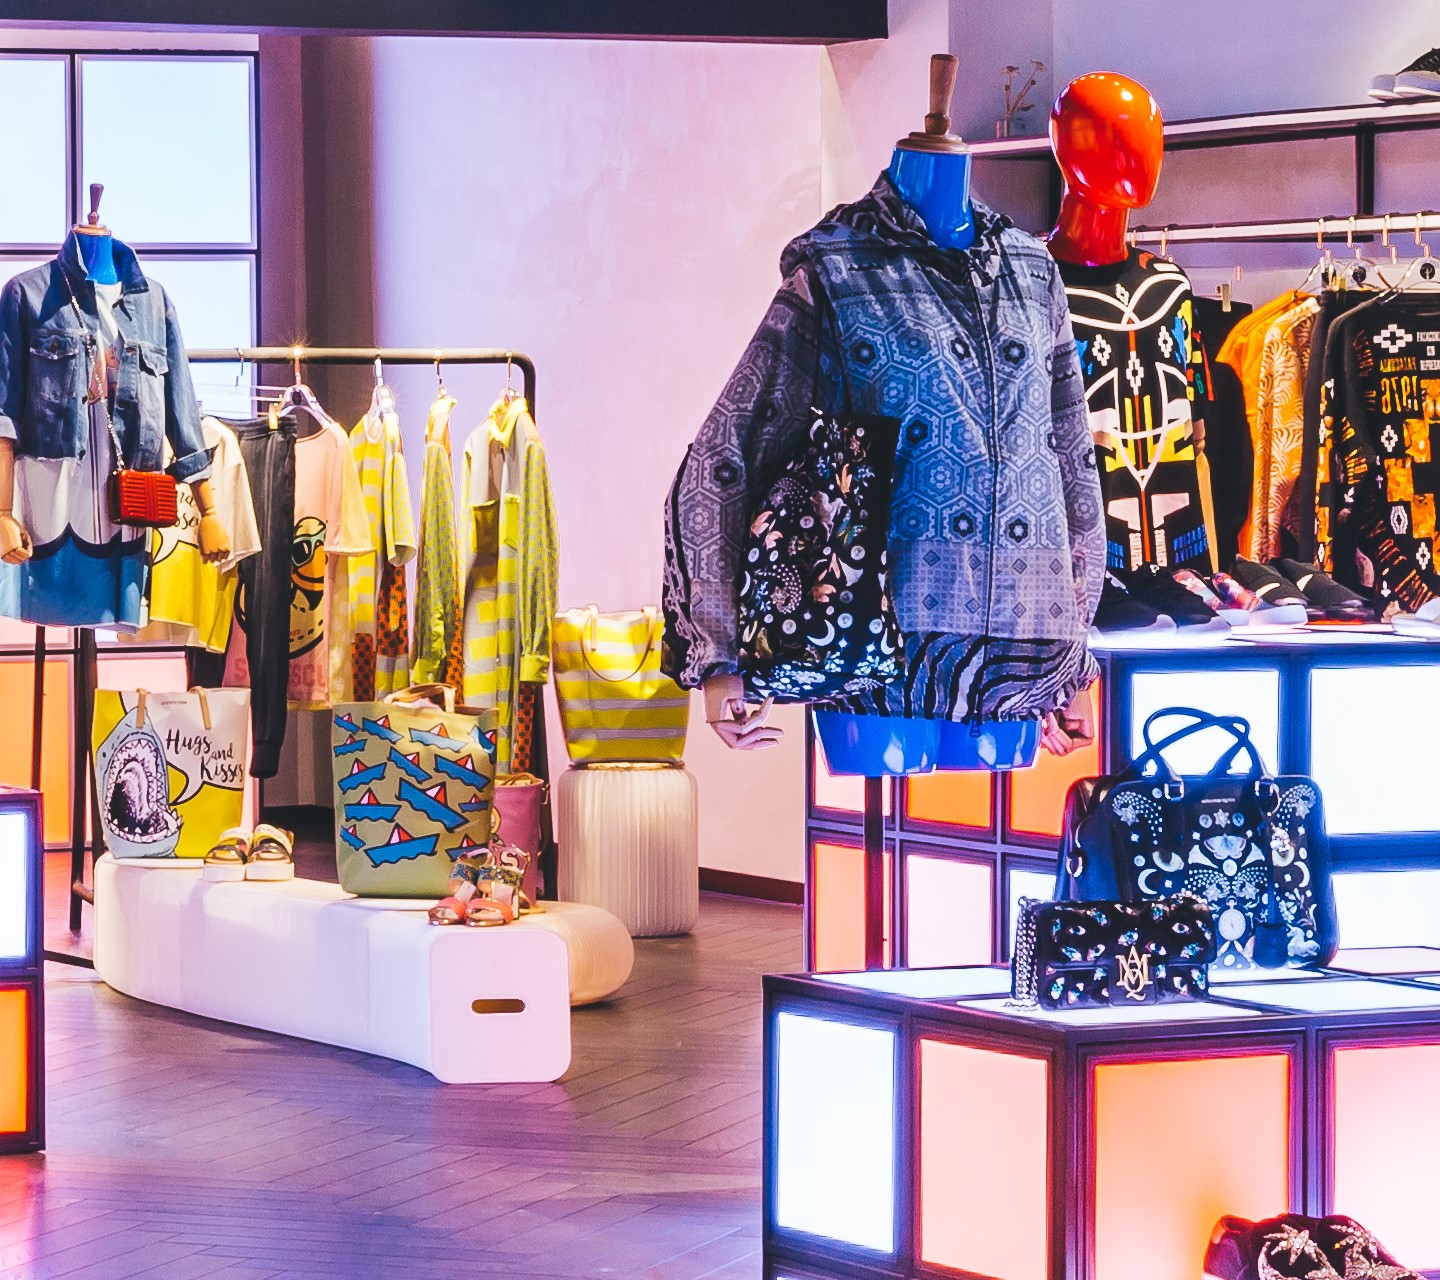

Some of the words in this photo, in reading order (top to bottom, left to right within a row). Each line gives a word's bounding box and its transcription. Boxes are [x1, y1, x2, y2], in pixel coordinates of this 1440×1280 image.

[166, 728, 212, 755] Hugs
[209, 742, 234, 761] and
[200, 756, 243, 783] Kisses
